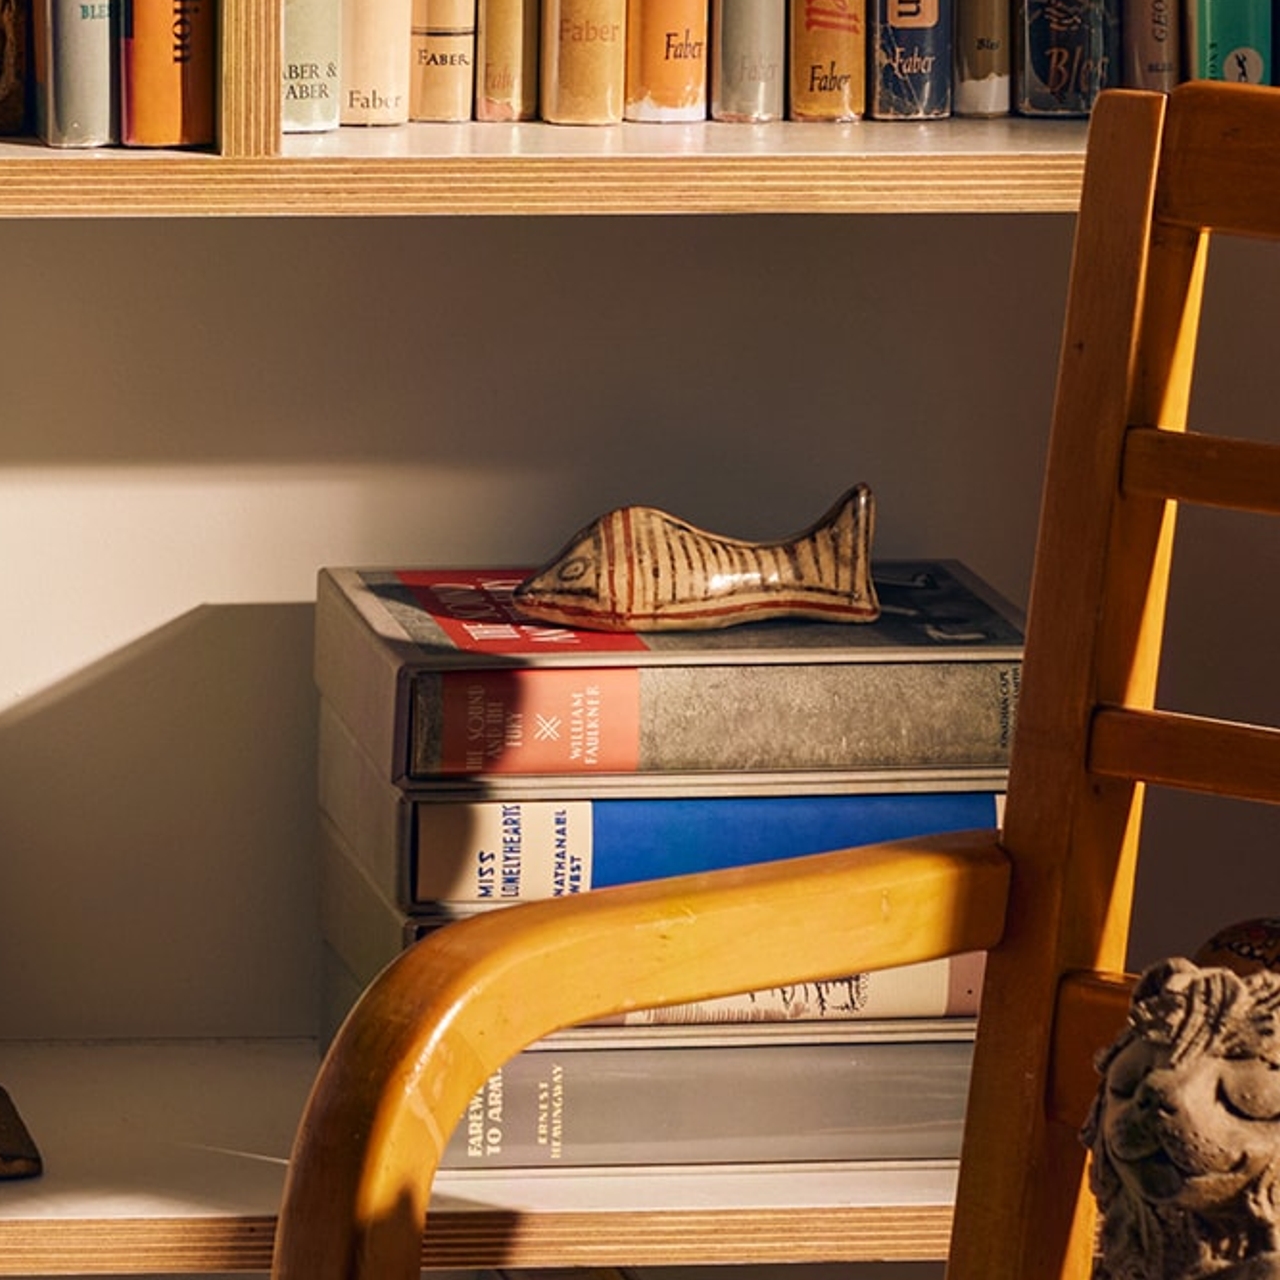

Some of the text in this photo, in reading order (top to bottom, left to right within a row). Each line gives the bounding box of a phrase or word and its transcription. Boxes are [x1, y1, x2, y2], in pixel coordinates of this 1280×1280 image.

[560, 19, 621, 44] Faber
[664, 29, 704, 61] Faber
[417, 49, 470, 67] FABER
[808, 60, 852, 93] Faber
[891, 46, 935, 78] Faber
[347, 89, 403, 110] Faber
[569, 692, 584, 760] WILLIAM
[583, 686, 600, 765] FAULKNER
[501, 804, 522, 898] LONELYHEARTS
[553, 809, 567, 897] NATHANAEL
[478, 851, 495, 898] MISS
[569, 855, 582, 894] WEST
[486, 1068, 503, 1157] TO ARM
[550, 1063, 563, 1159] HEMINGWAY
